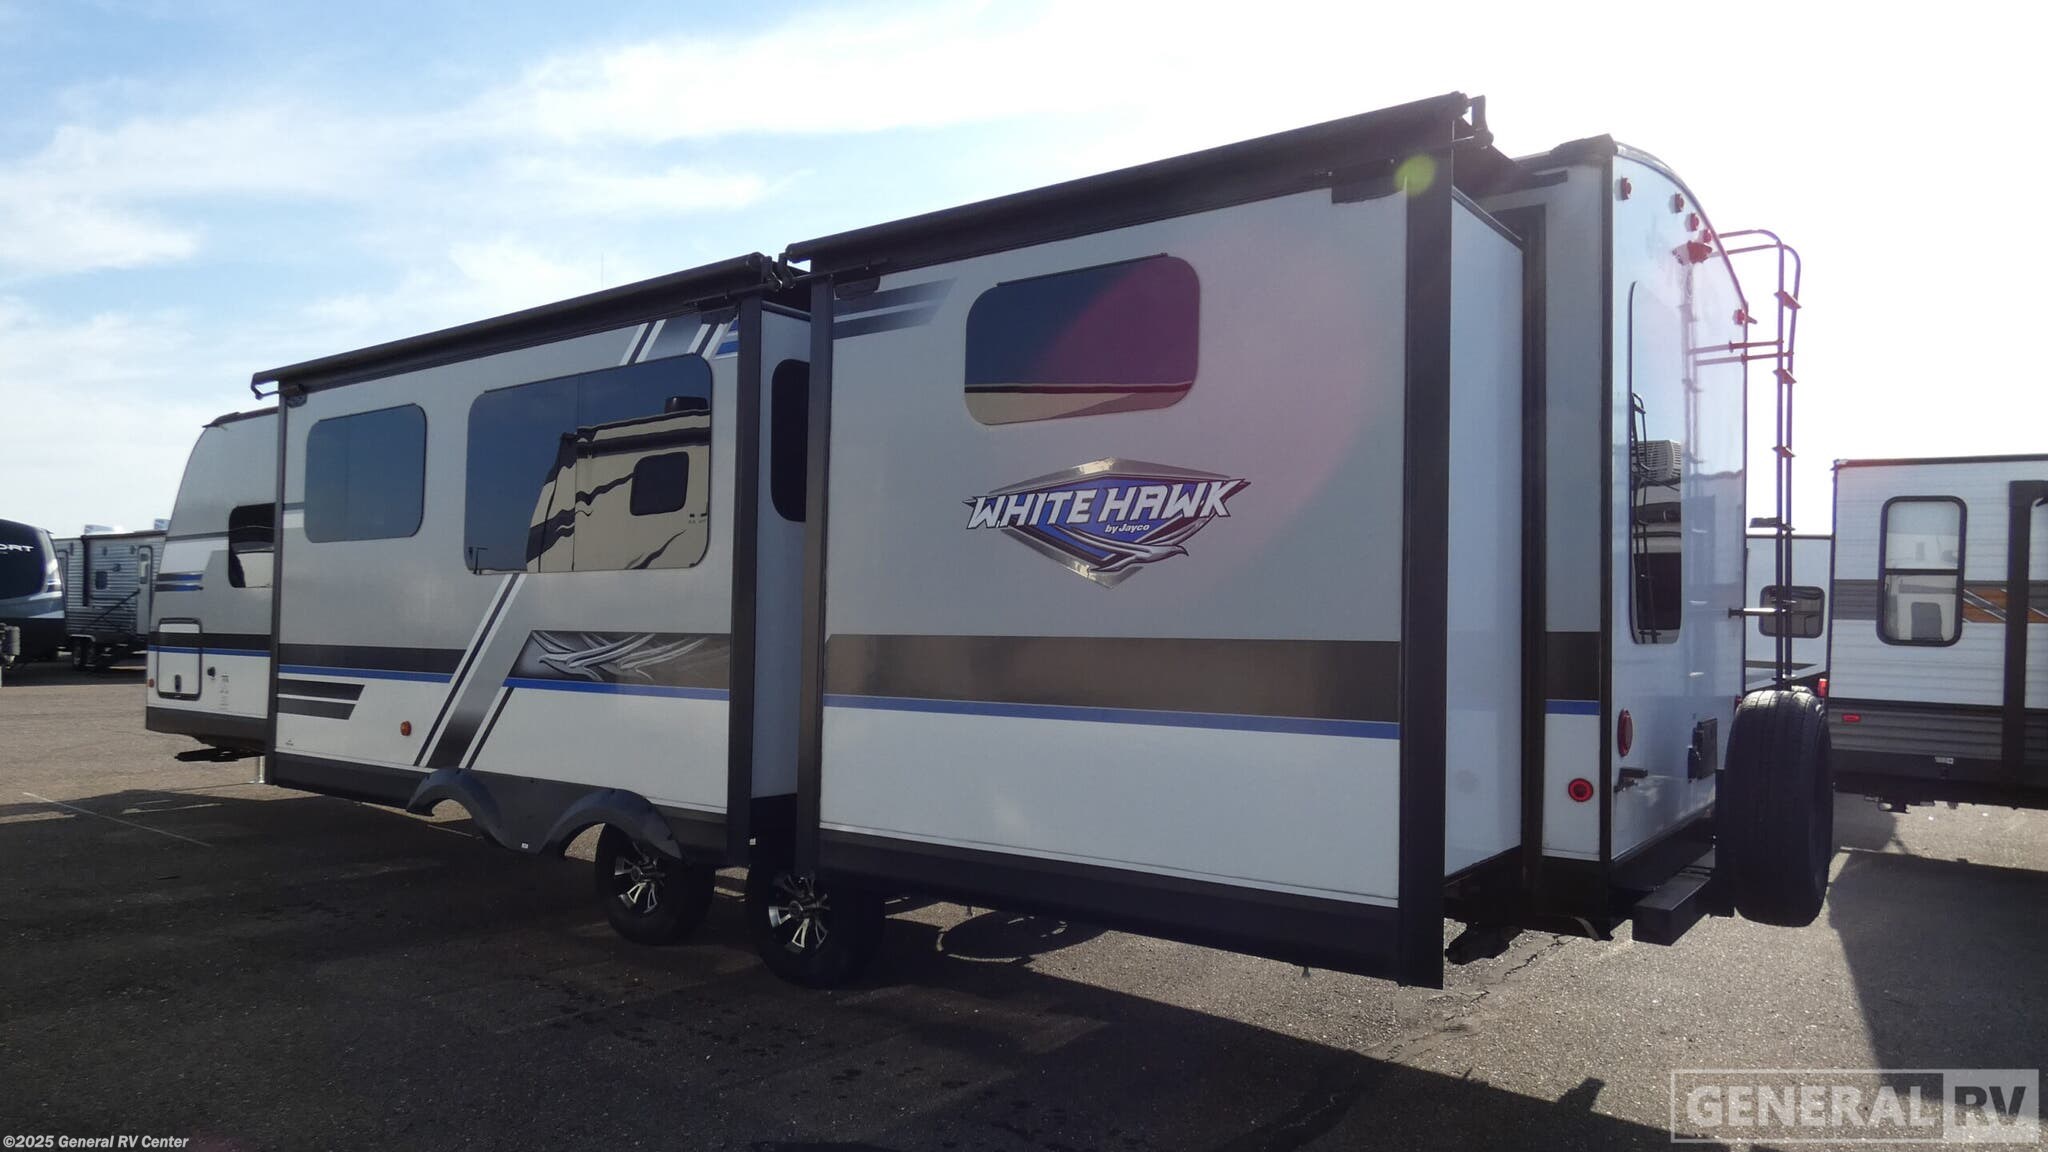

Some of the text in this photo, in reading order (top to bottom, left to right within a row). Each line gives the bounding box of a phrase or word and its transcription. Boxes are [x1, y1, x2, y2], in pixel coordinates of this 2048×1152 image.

[964, 478, 1251, 530] WHITE HAWK
[1104, 523, 1150, 534] by Jayco
